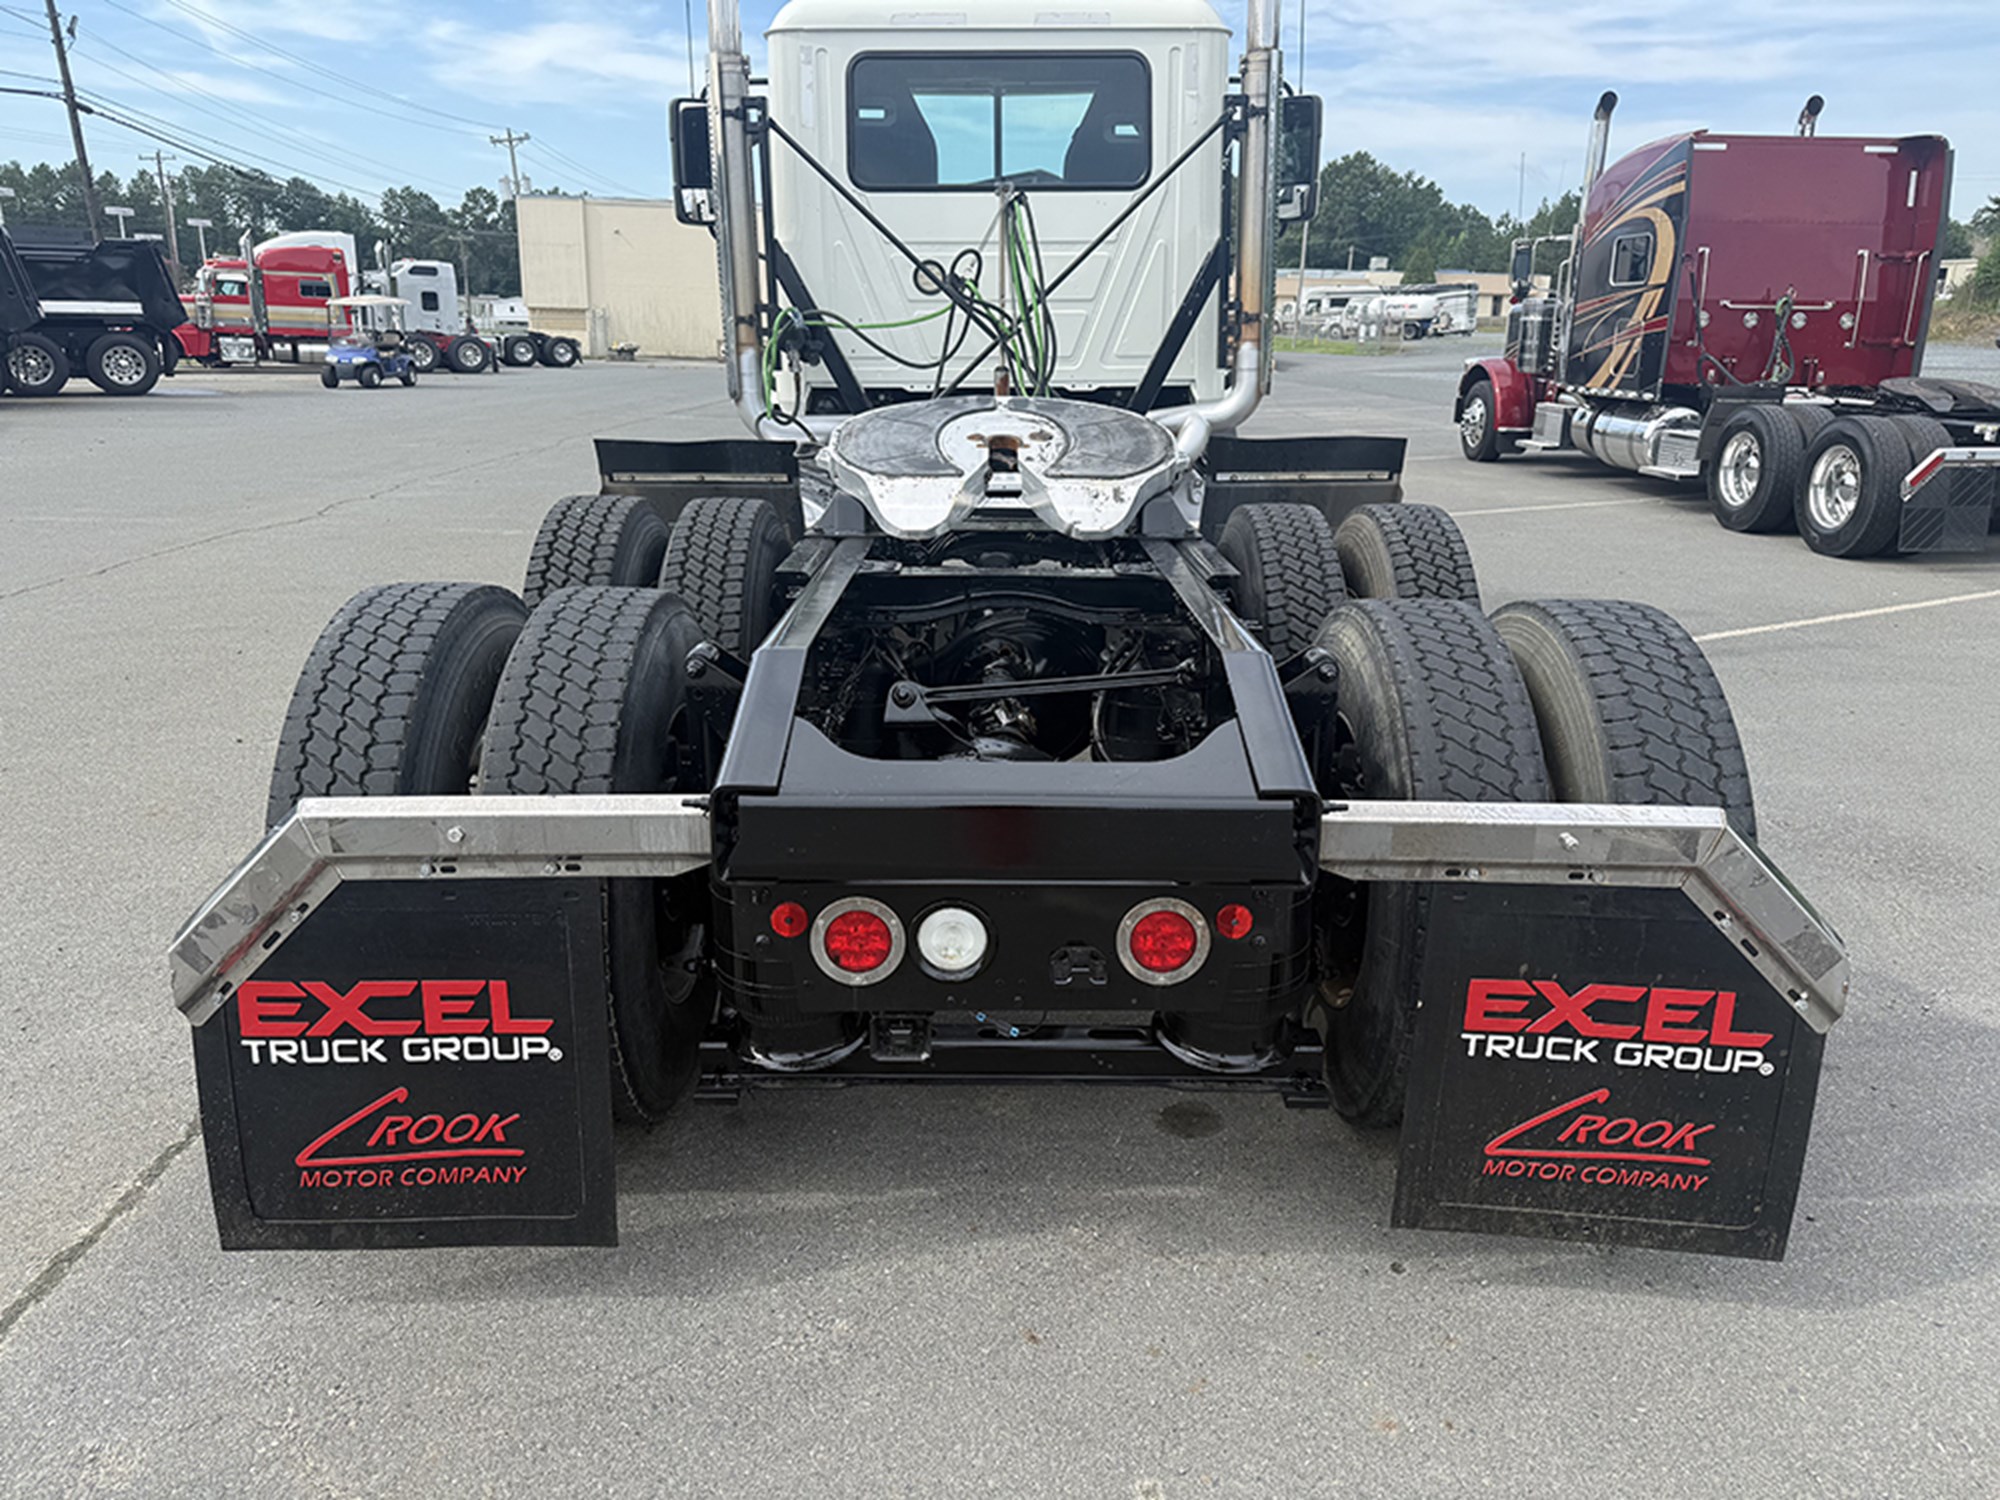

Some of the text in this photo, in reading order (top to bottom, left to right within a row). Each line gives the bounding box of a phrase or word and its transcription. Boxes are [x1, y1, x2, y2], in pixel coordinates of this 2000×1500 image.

[236, 979, 555, 1038] EXCEL
[1463, 978, 1774, 1049] EXCEL
[240, 1038, 388, 1065] TRUCK
[1460, 1033, 1600, 1063] TRUCK
[300, 1166, 527, 1188] MOTOR COMPANY
[1482, 1159, 1709, 1192] MOTOR COMPANY
